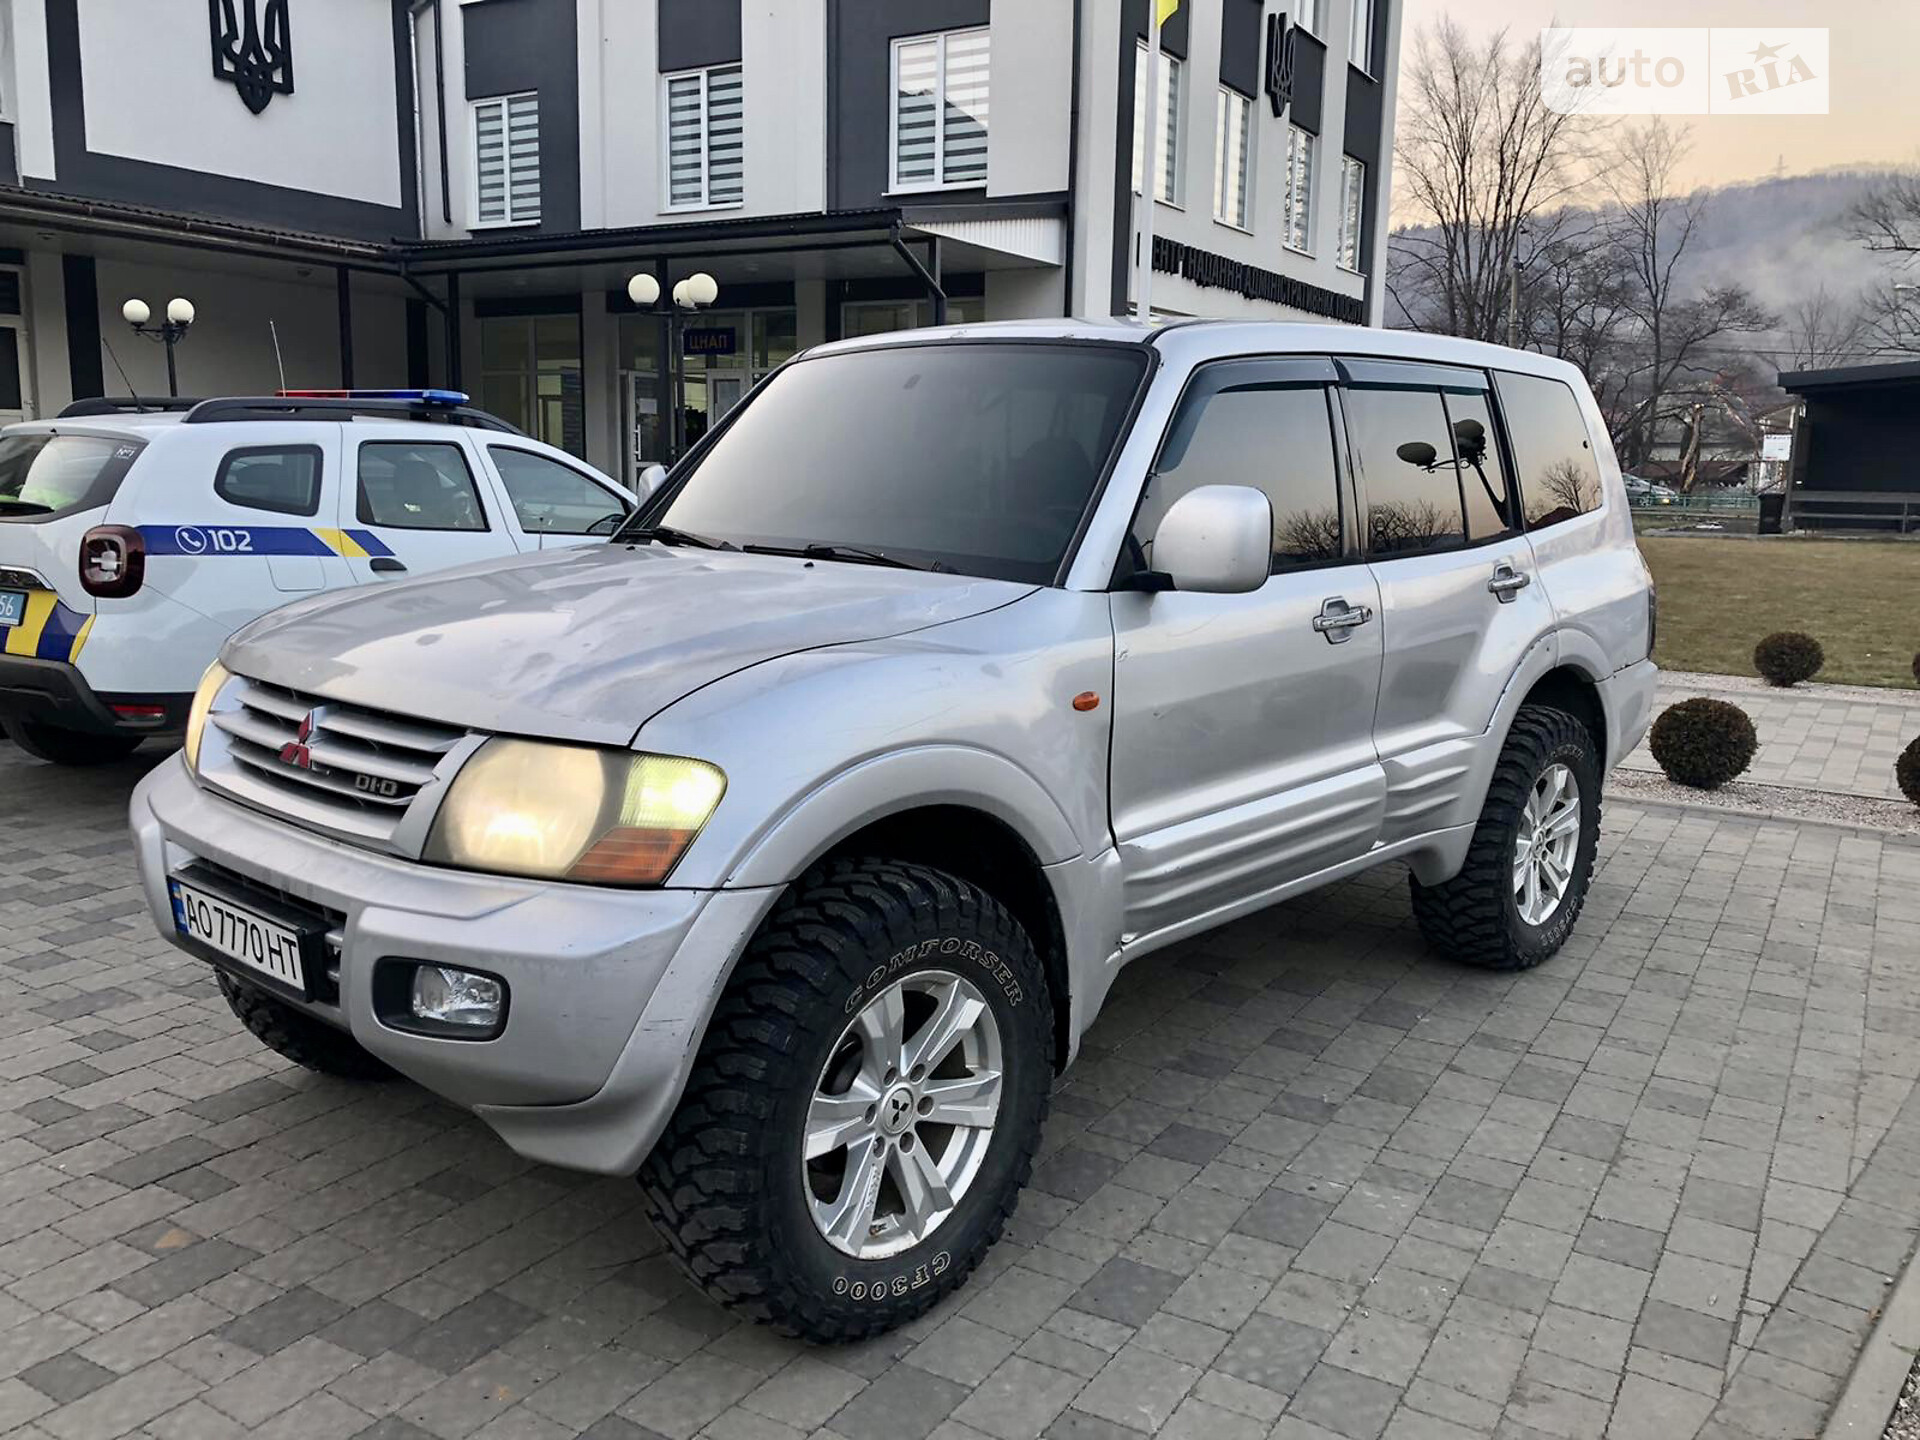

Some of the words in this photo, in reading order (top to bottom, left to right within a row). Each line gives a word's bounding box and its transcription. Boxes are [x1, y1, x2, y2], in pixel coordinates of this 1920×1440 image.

[1137, 233, 1184, 275] ЕНТР
[1182, 246, 1243, 294] НАДАННЯ
[689, 334, 728, 350] ЦНАП
[208, 530, 253, 551] 102
[844, 937, 1024, 1014] COMFORSER
[832, 1250, 952, 1301] CF3000
